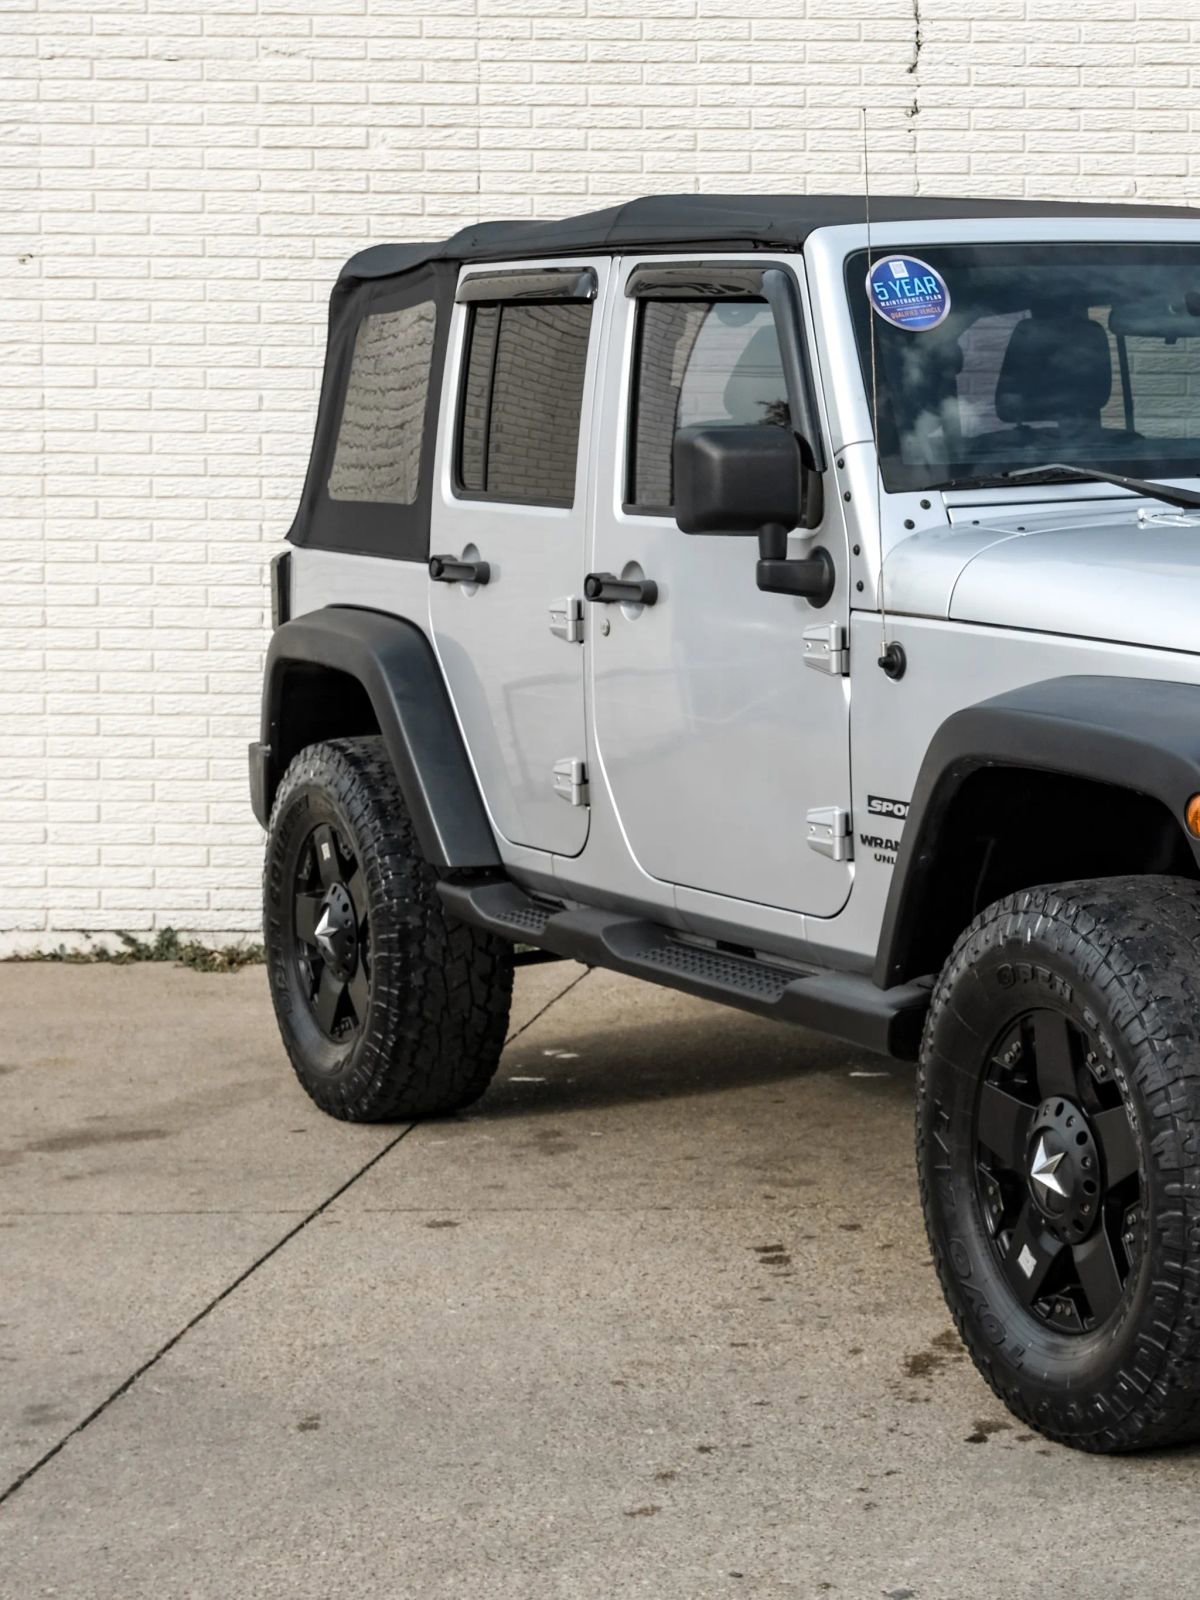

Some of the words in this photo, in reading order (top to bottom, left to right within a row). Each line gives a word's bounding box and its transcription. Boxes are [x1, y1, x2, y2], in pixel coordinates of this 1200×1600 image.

[873, 282, 889, 300] 5
[888, 276, 939, 297] YEAR
[880, 297, 924, 307] MAINTENANCE
[996, 962, 1073, 1003] OPEN
[948, 1238, 1027, 1371] TOYO
